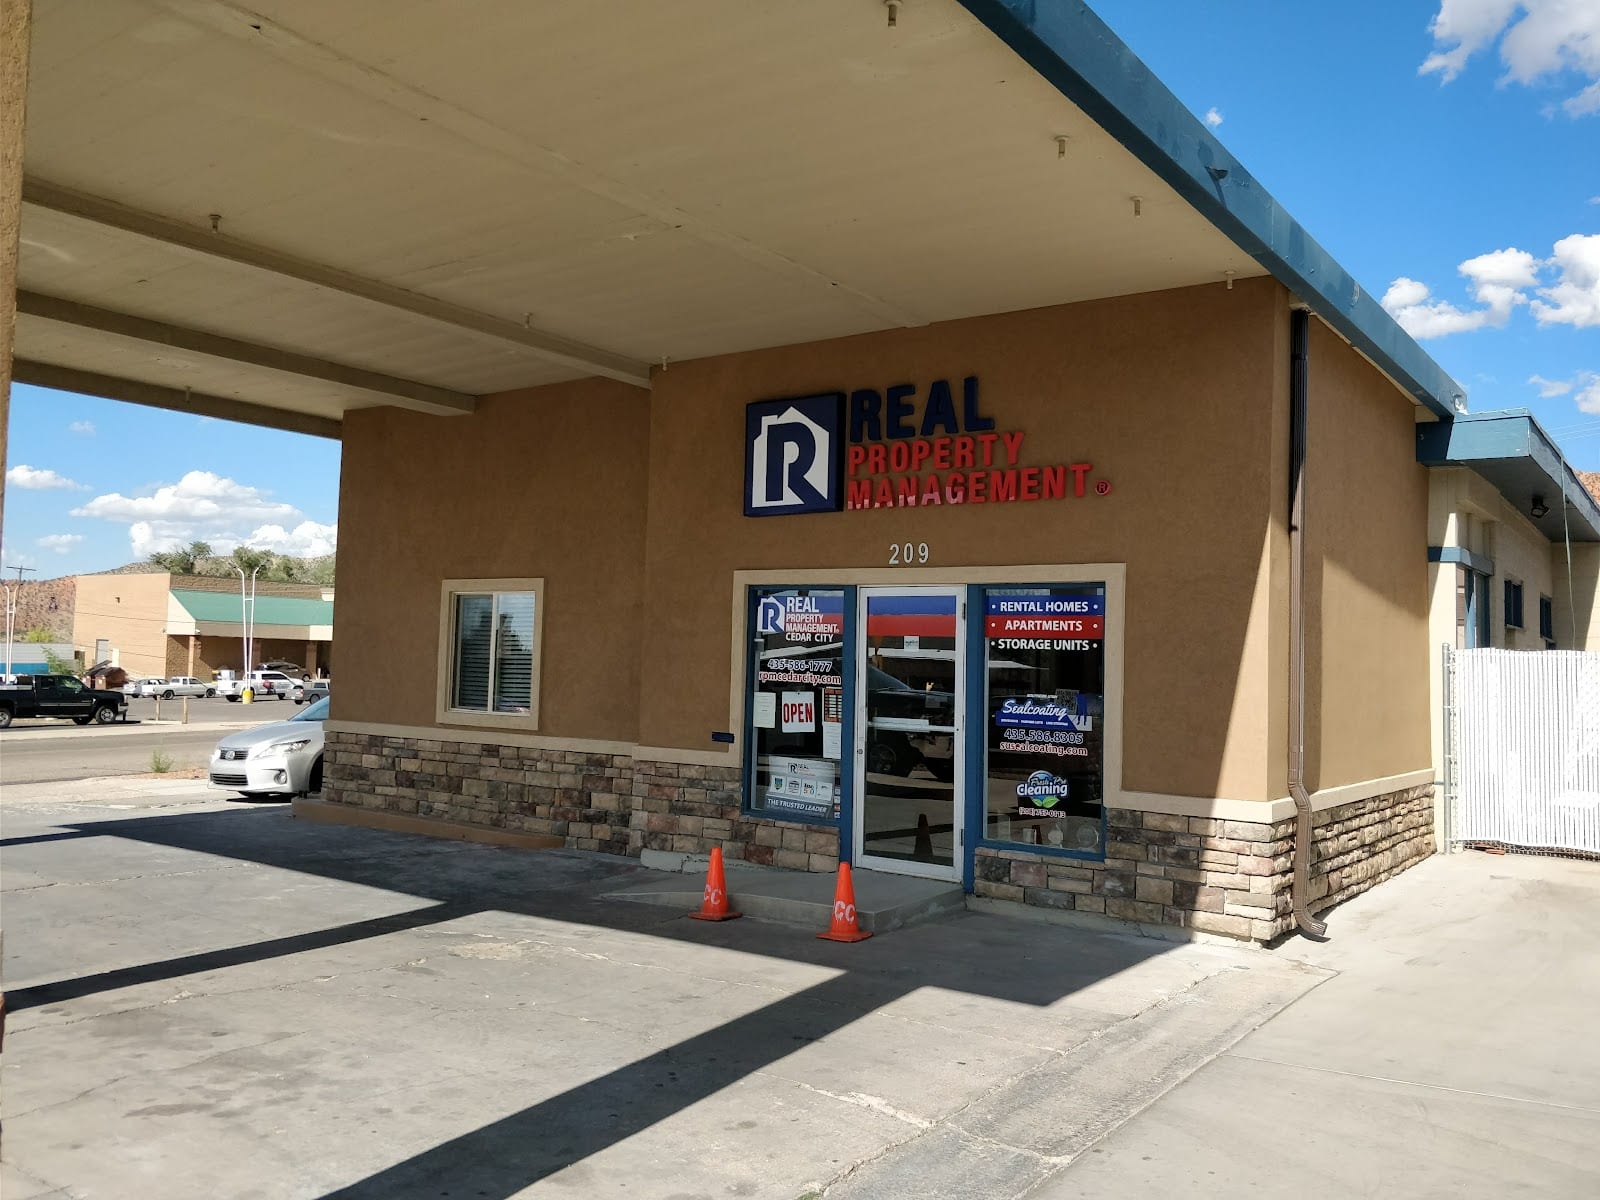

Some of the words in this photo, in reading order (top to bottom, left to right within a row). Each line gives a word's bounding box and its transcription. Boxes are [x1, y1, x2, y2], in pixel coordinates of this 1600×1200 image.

[849, 376, 995, 442] REAL
[848, 432, 1025, 476] PROPERTY
[847, 463, 1093, 510] MANAGEMENT
[888, 542, 930, 564] 209
[786, 596, 819, 613] REAL
[1000, 601, 1044, 612] RENTAL
[1045, 601, 1089, 612] HOMES
[786, 613, 824, 623] PROPERTY
[785, 623, 838, 633] MANAGEMENT
[1004, 620, 1083, 632] APARTMENTS
[785, 632, 812, 642] CEDAR
[814, 633, 834, 643] CITY
[998, 638, 1051, 650] STORAGE
[1053, 639, 1090, 651] UNITS
[767, 658, 833, 673] 435-586-1777
[783, 702, 813, 723] OPEN
[1002, 699, 1068, 721] Sealcoating
[1004, 728, 1084, 745] 435.586.8305
[1016, 782, 1068, 797] Cleaning
[768, 798, 779, 806] THE
[780, 800, 805, 810] TRUSTED
[805, 804, 828, 813] LEADER
